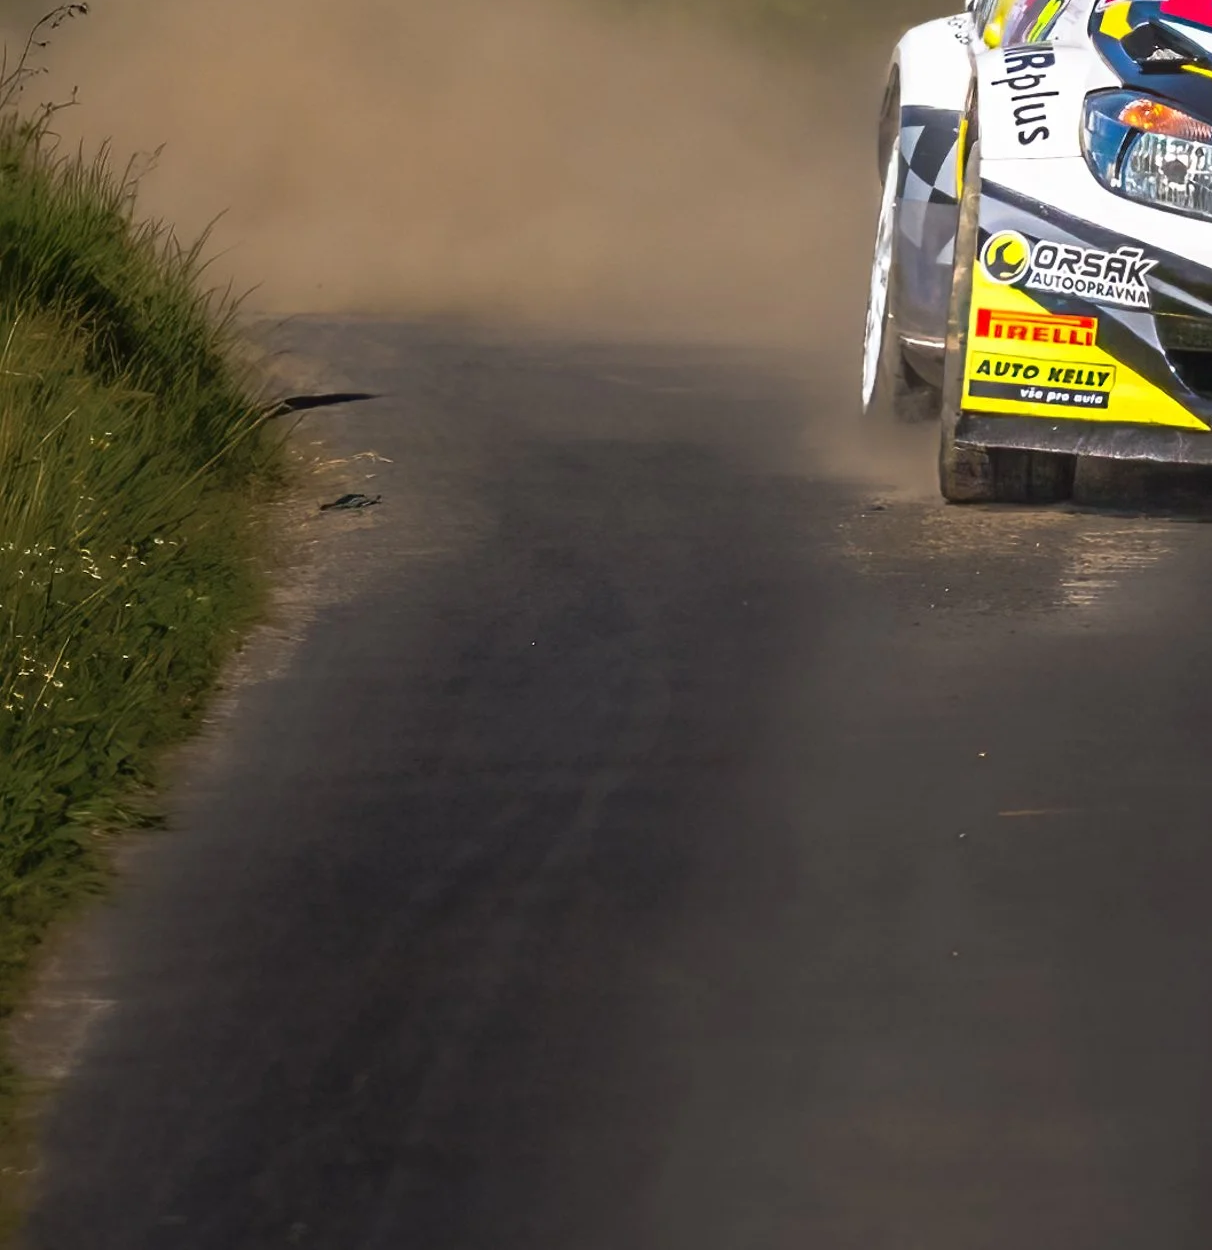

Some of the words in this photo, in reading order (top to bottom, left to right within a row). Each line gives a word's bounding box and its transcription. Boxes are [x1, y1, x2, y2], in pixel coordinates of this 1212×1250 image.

[1031, 271, 1150, 304] AUTOOPRAVNA
[975, 308, 1096, 346] PIRELLI
[976, 359, 1040, 380] AUTO
[1047, 366, 1111, 388] KELLY
[1046, 390, 1070, 403] pro
